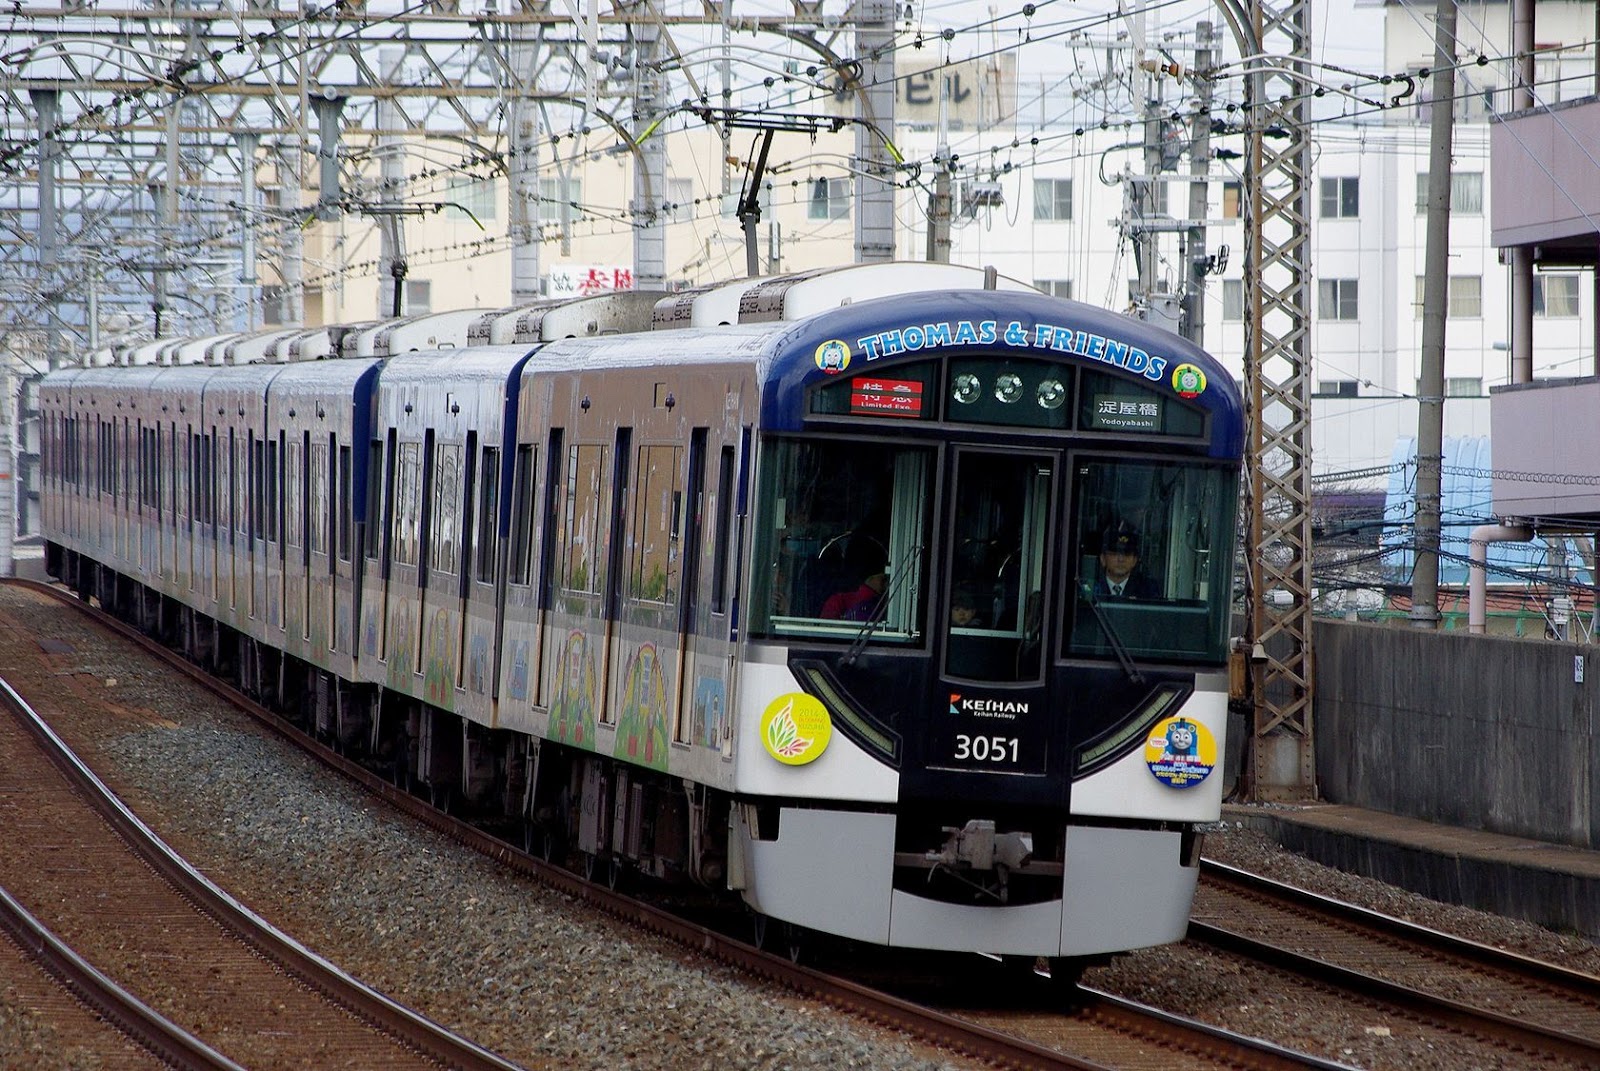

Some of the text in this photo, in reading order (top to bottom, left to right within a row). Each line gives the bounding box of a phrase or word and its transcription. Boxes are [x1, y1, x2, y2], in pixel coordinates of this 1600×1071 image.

[857, 320, 1167, 381] THOMAS & FRIENDS
[861, 401, 892, 409] Limited
[1098, 400, 1158, 416] 淀屋橋
[1101, 418, 1153, 427] Yodoyabashi
[962, 699, 1029, 714] KEIHAN
[994, 712, 1016, 720] Railway
[954, 734, 1019, 762] 3051
